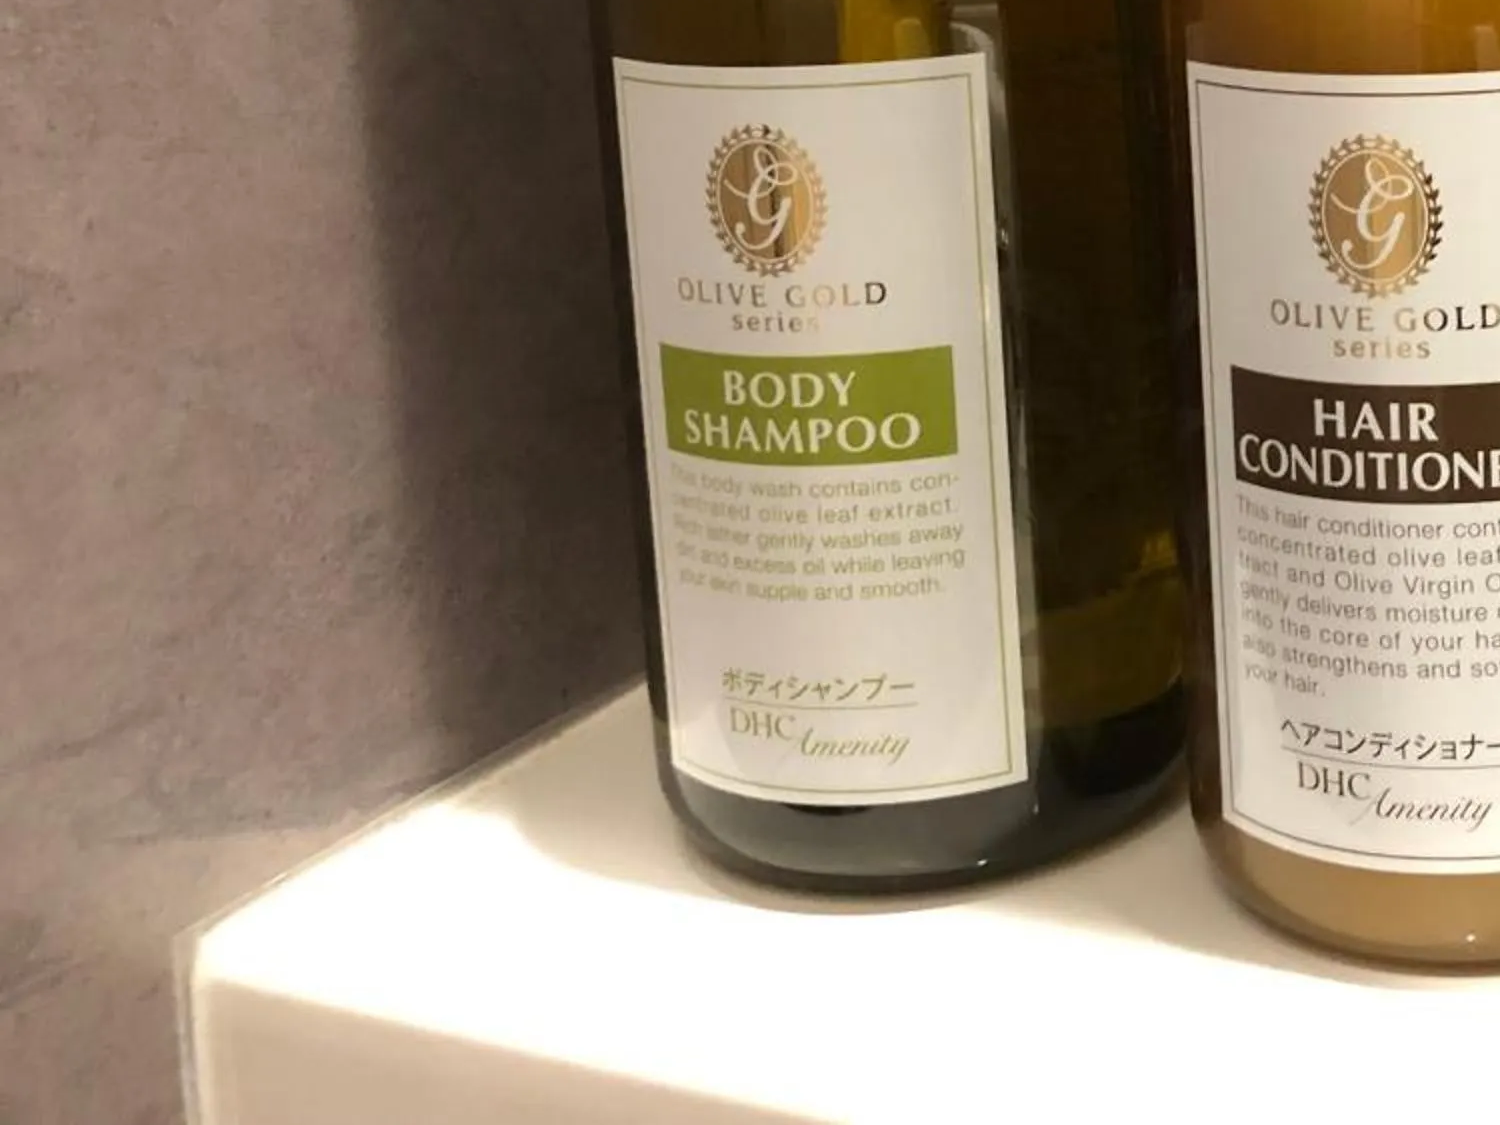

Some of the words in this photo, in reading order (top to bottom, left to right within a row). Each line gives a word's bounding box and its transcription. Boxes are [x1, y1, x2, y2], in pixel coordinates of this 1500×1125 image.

[677, 277, 768, 308] OLIVE
[785, 281, 887, 308] GOLD
[1270, 298, 1375, 332] OLIVE
[1333, 336, 1431, 359] series
[723, 369, 856, 409] BODY
[683, 409, 922, 454] SHAMPOO
[1313, 397, 1439, 442] HAIR
[749, 480, 802, 497] wash
[808, 479, 902, 498] contains
[910, 473, 960, 492] con-
[758, 505, 809, 524] olive
[817, 504, 859, 523] leaf
[1236, 493, 1269, 522] This
[1274, 506, 1311, 529] hair
[1317, 515, 1444, 540] conditioner
[757, 531, 815, 554] gently
[820, 529, 902, 549] washes
[909, 523, 965, 544] away
[1237, 525, 1376, 566] concentrated
[1387, 547, 1446, 568] olive
[802, 557, 825, 575] oil
[832, 555, 886, 574] while
[891, 548, 966, 571] leaving
[1238, 549, 1278, 577] tract
[1287, 567, 1325, 588] and
[1334, 570, 1393, 595] Olive
[1402, 575, 1475, 600] Virgin
[815, 583, 854, 601] and
[1240, 580, 1290, 612] gently
[1297, 592, 1377, 622] delivers
[1385, 605, 1489, 623] moisture
[1242, 608, 1273, 630] into
[1280, 617, 1311, 641] the
[1319, 628, 1370, 648] core
[1379, 631, 1401, 650] of
[1412, 633, 1464, 656] your
[1282, 647, 1407, 678] strengthens
[1417, 659, 1461, 679] and
[1284, 668, 1326, 697] hair.
[730, 706, 796, 742] DHC
[792, 727, 911, 766] Amenity
[1297, 760, 1372, 801] DHC
[1366, 786, 1493, 832] Amenity
